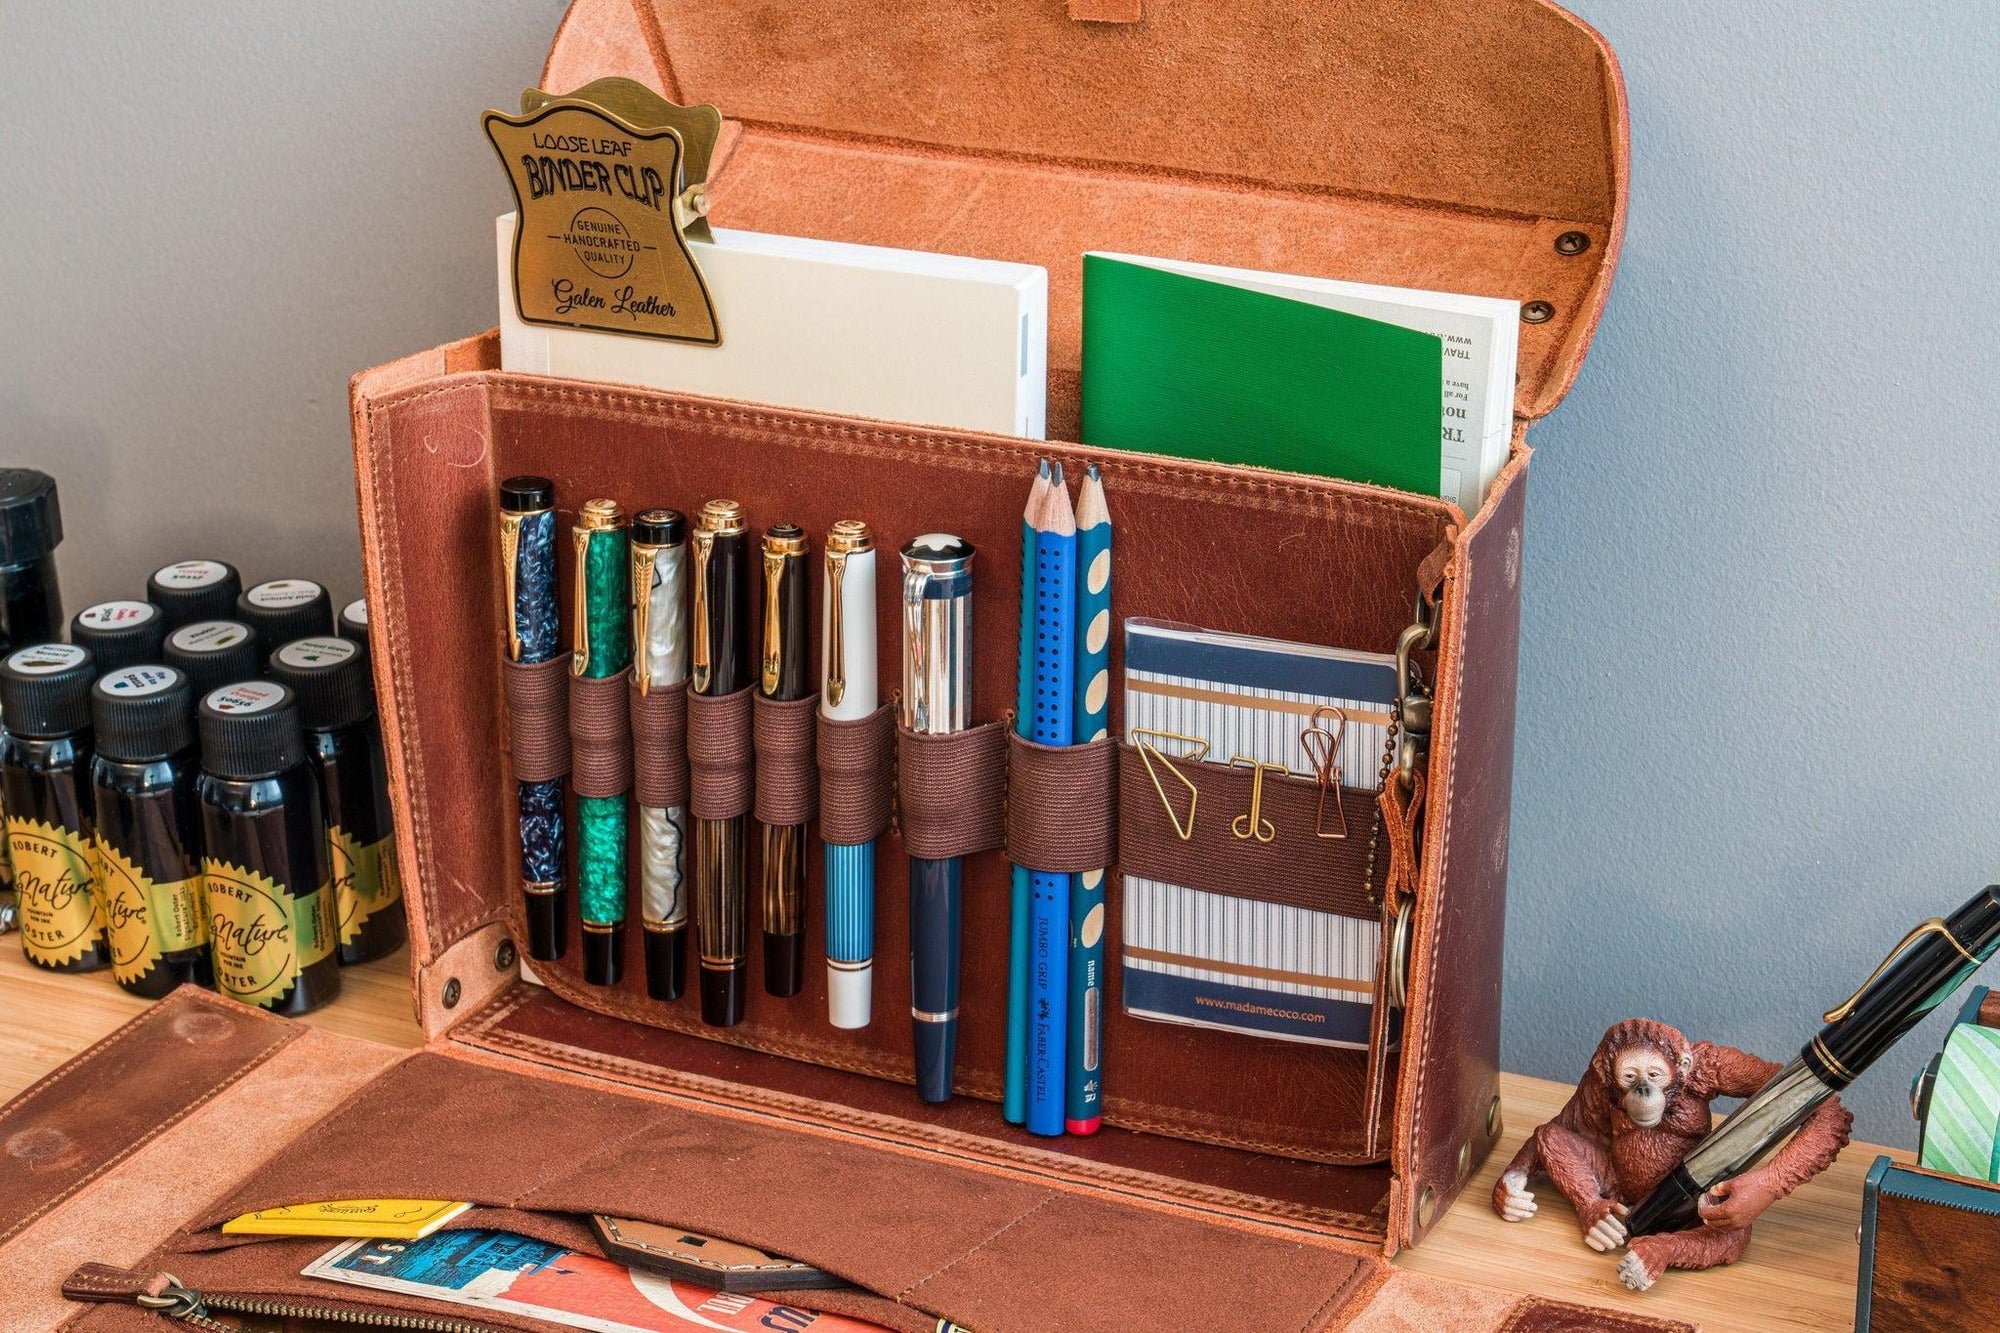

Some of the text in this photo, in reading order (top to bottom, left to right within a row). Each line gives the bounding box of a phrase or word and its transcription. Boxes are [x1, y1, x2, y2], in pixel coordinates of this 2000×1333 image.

[532, 132, 632, 157] LOOSE LEAF
[521, 153, 665, 211] BINDER CLIP
[577, 219, 622, 235] GENUINE
[563, 232, 641, 252] HANDCRAFTED
[583, 250, 625, 265] QUALITY
[551, 278, 676, 322] Galen Leather
[1443, 390, 1469, 402] For all
[1442, 406, 1467, 420] no
[24, 924, 65, 942] OSTER
[1087, 960, 1095, 986] name
[1036, 916, 1050, 1103] JUMBO GRIP FABER-CASTELL
[1195, 995, 1326, 1024] www.madamecoco.com
